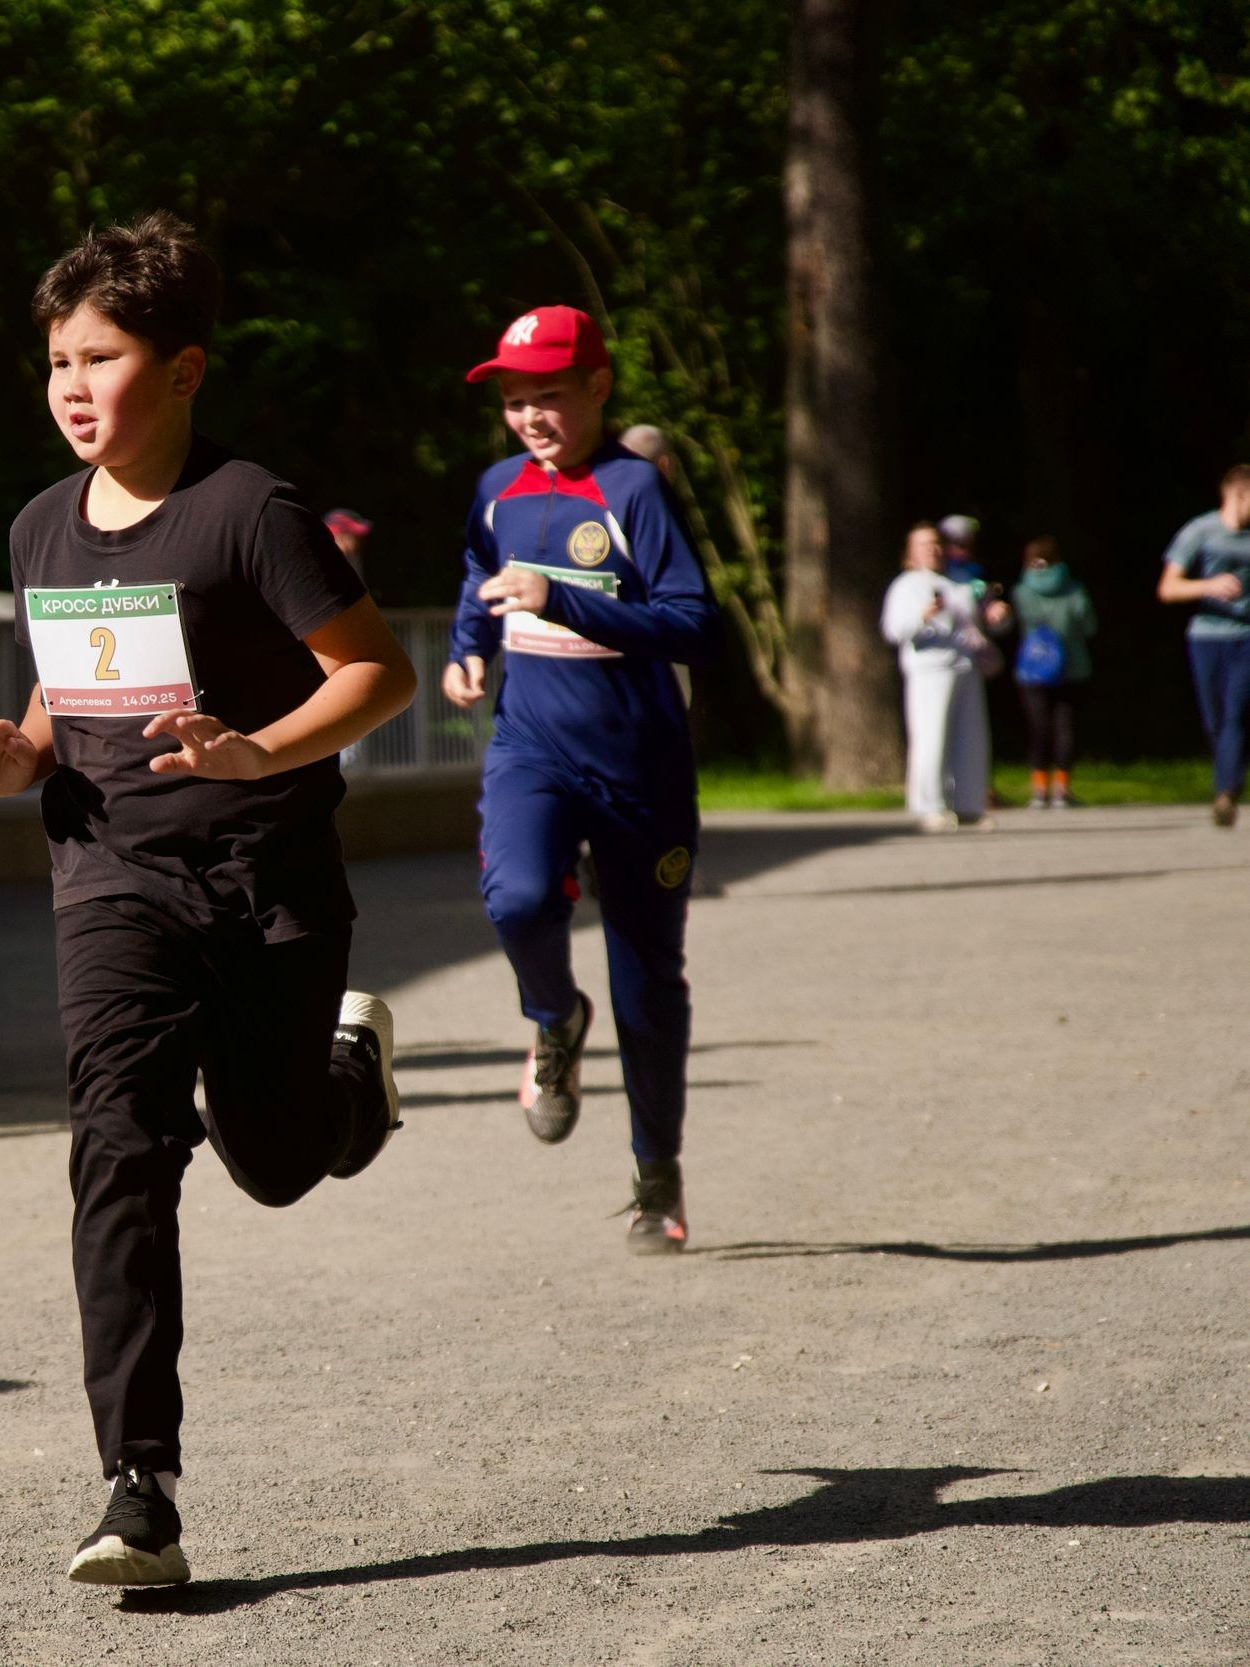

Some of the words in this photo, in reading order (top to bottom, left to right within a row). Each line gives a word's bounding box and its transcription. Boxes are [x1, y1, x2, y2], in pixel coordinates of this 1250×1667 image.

[41, 599, 97, 614] КРОСС
[101, 595, 160, 615] ДУБКИ
[90, 627, 120, 680] 2
[59, 696, 112, 708] Апрелевка
[122, 693, 177, 706] 14.09.25
[336, 1032, 358, 1042] FILA
